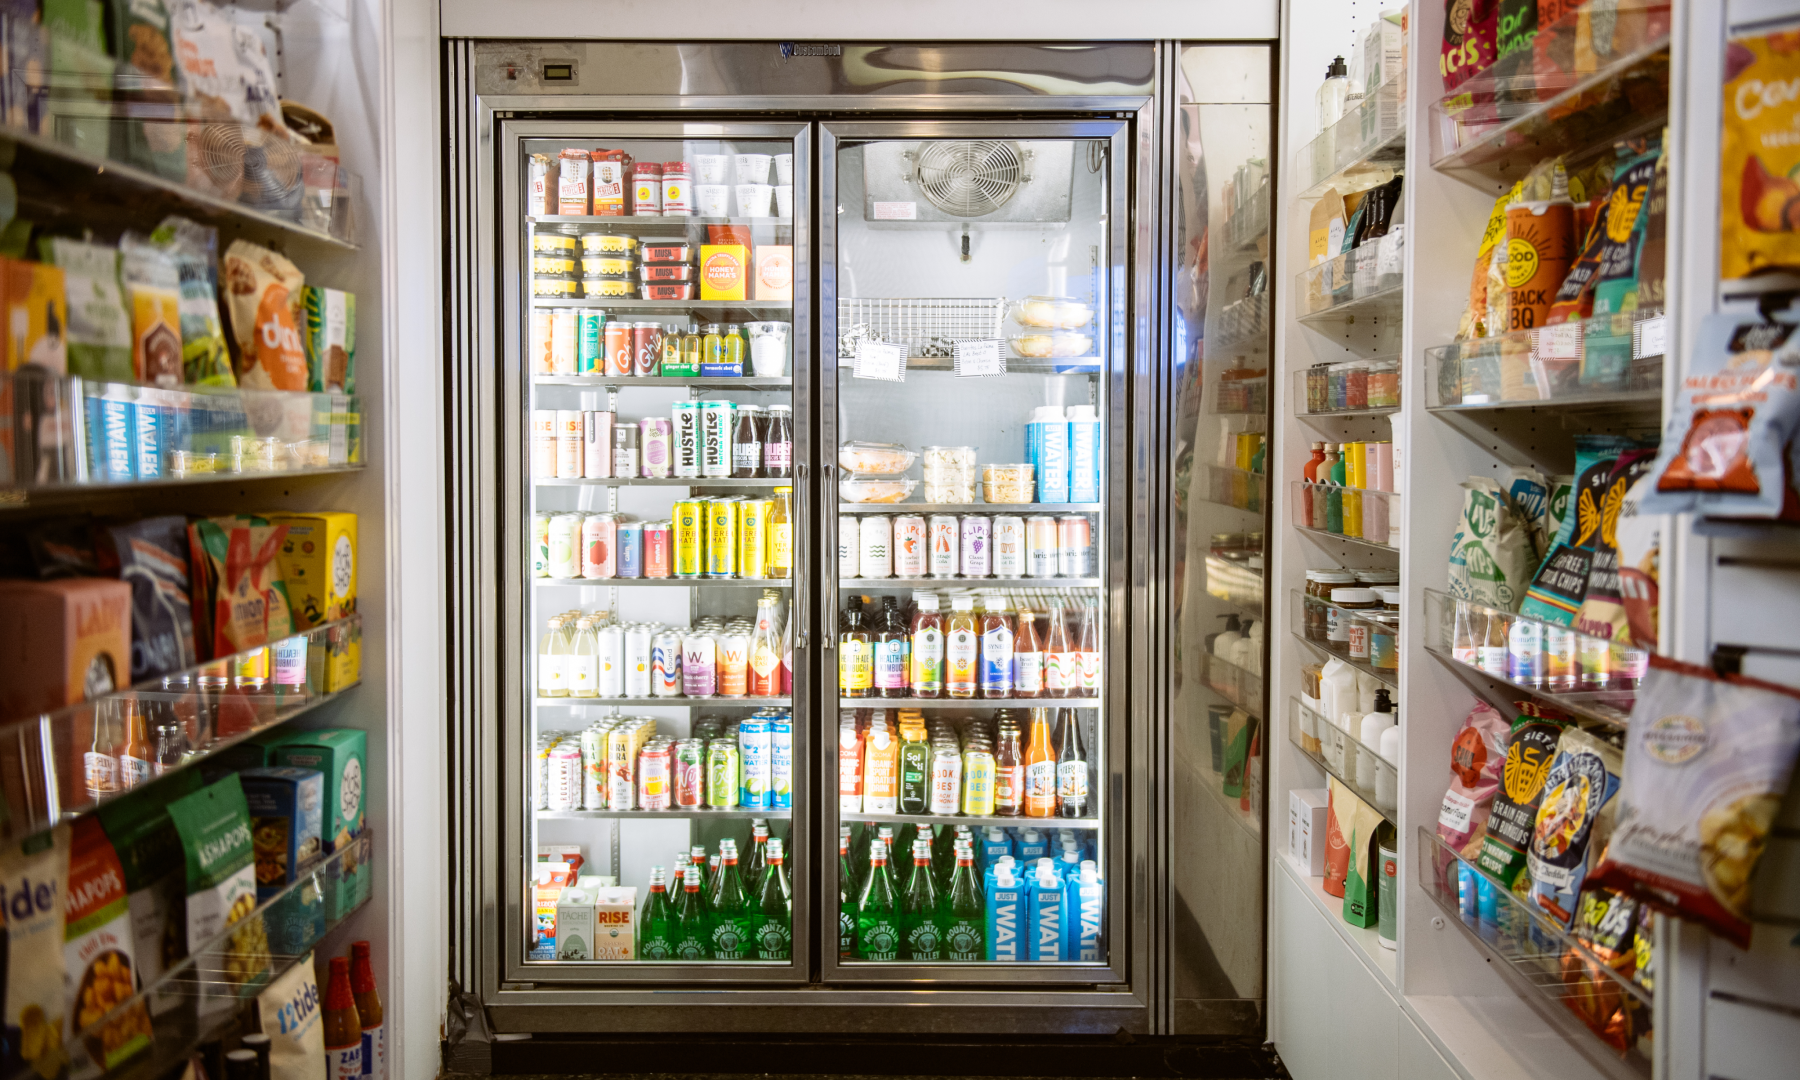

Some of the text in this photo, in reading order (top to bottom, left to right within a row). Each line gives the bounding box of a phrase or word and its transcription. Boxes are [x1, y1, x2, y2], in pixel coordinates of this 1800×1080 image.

[794, 44, 841, 57] CustomCool
[655, 249, 672, 257] MUSH
[1508, 251, 1534, 264] OOD
[655, 268, 673, 276] MUSH
[657, 287, 675, 295] MUSH
[639, 332, 661, 368] Ghia
[535, 421, 552, 431] ISE
[1045, 431, 1062, 489] WATER
[1076, 431, 1093, 489] WATER
[880, 664, 908, 672] KOMBUCHA
[1522, 731, 1557, 751] SIETE
[840, 759, 860, 767] GANIC
[868, 760, 894, 768] ORGANIC
[840, 767, 856, 775] PORT
[871, 768, 889, 776] SPORT
[871, 784, 890, 792] DRINK
[936, 782, 955, 791] BEST
[969, 782, 991, 792] BEST
[1492, 800, 1530, 827] GRAIN FREE
[1480, 855, 1505, 876] CRISPS
[1040, 893, 1059, 901] JUST
[537, 900, 558, 908] RIZON
[598, 911, 630, 924] RISE
[711, 923, 748, 942] MOUNTAIN
[755, 923, 792, 942] MOUNTAIN
[863, 924, 900, 944] MOUNTAIN
[907, 924, 942, 944] MOUNTAIN
[945, 924, 981, 944] MOUNTAIN
[598, 947, 621, 955] OAT
[642, 940, 673, 955] MOUNTAIN
[676, 940, 706, 956] MOUNTAIN
[714, 950, 744, 960] VALLEY
[759, 950, 788, 960] VALLEY
[868, 951, 896, 961] VALLEY
[912, 951, 940, 961] VALLEY
[948, 951, 978, 961] VALLEY
